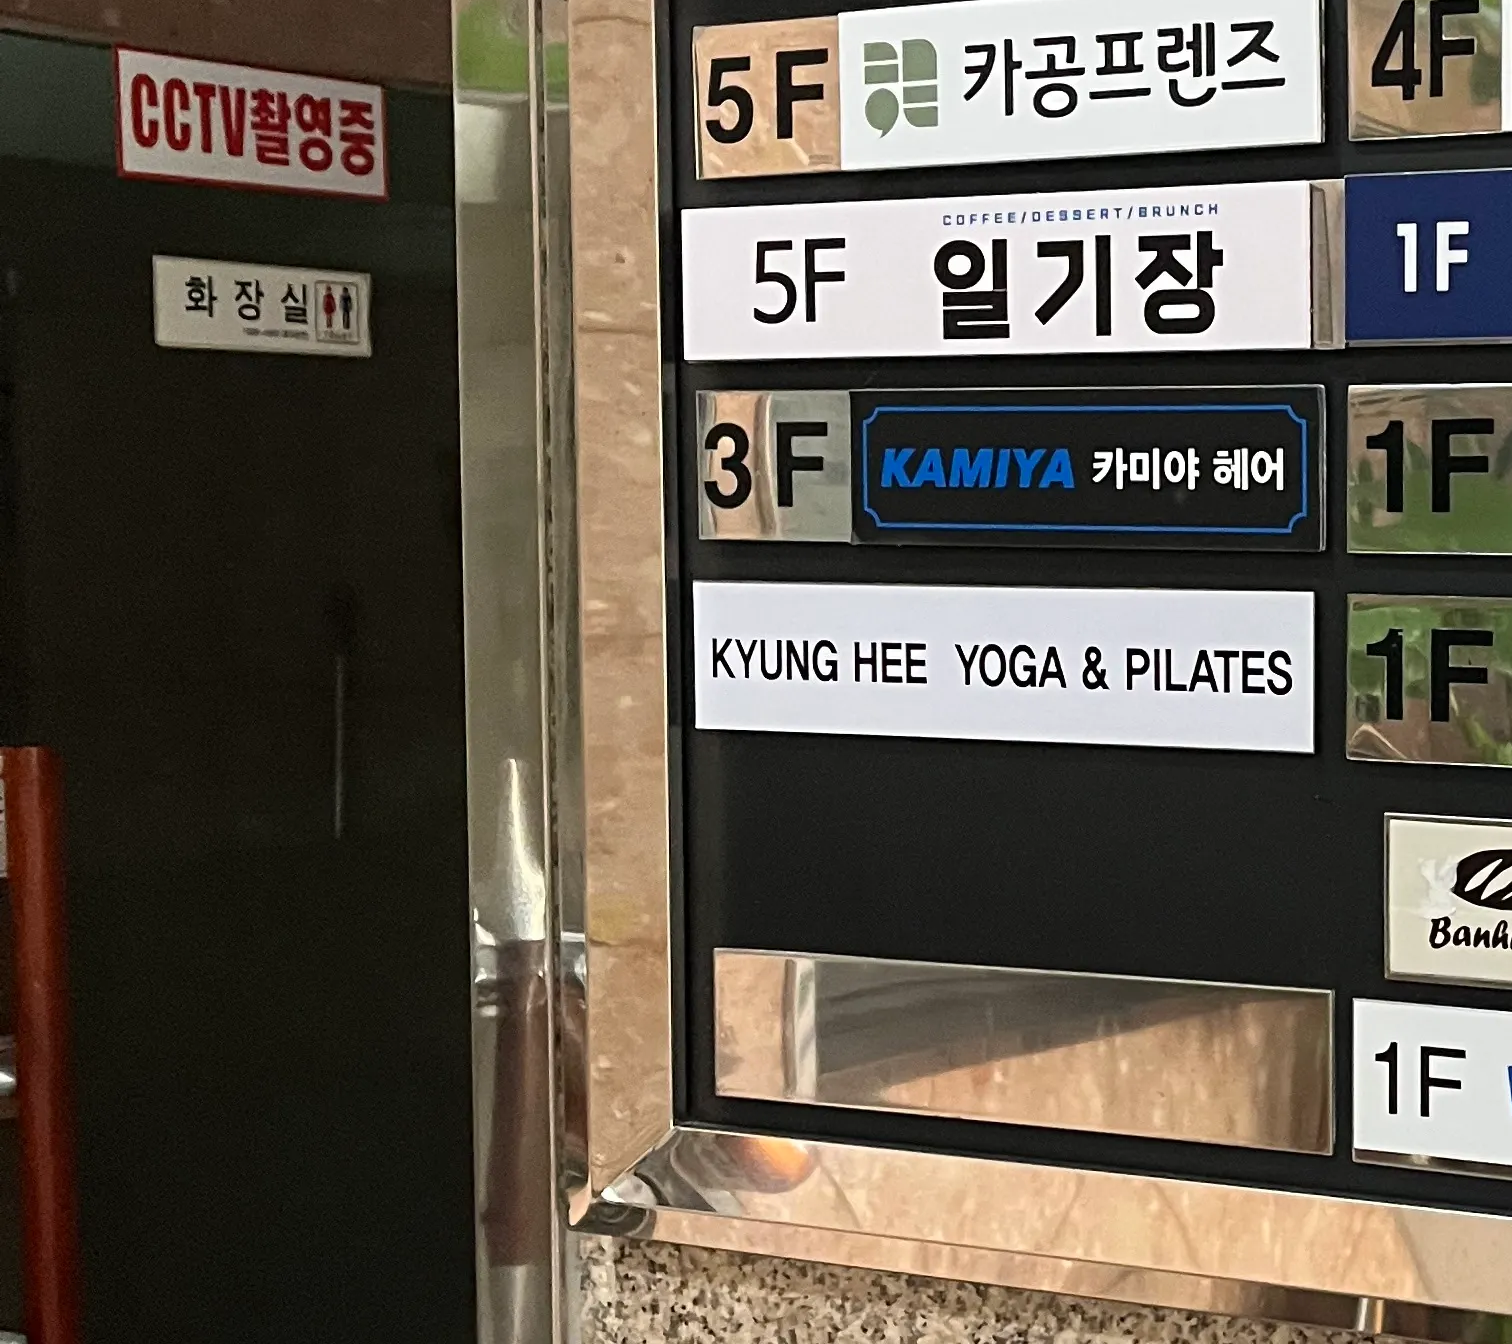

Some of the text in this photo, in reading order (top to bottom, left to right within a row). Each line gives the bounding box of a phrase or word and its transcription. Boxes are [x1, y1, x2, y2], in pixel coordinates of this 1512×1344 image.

[705, 47, 828, 144] 5F
[963, 20, 1286, 118] 카공프렌즈
[131, 73, 375, 176] CCTV촬영중
[942, 203, 1220, 227] COFFEE/DESSERT/BRUNCH
[1396, 221, 1470, 293] 1F
[184, 275, 309, 324] 화장실
[753, 237, 846, 325] 5F
[933, 230, 1224, 340] 일기장
[704, 422, 829, 509] 3F
[880, 448, 1076, 489] KAMIYA
[1092, 448, 1285, 491] 카미야 헤어
[1366, 418, 1494, 513] 1F
[711, 638, 1294, 696] KYUNG HEE YOGA & PILATES
[1366, 628, 1494, 723] 1F
[1374, 1041, 1467, 1118] 1F
